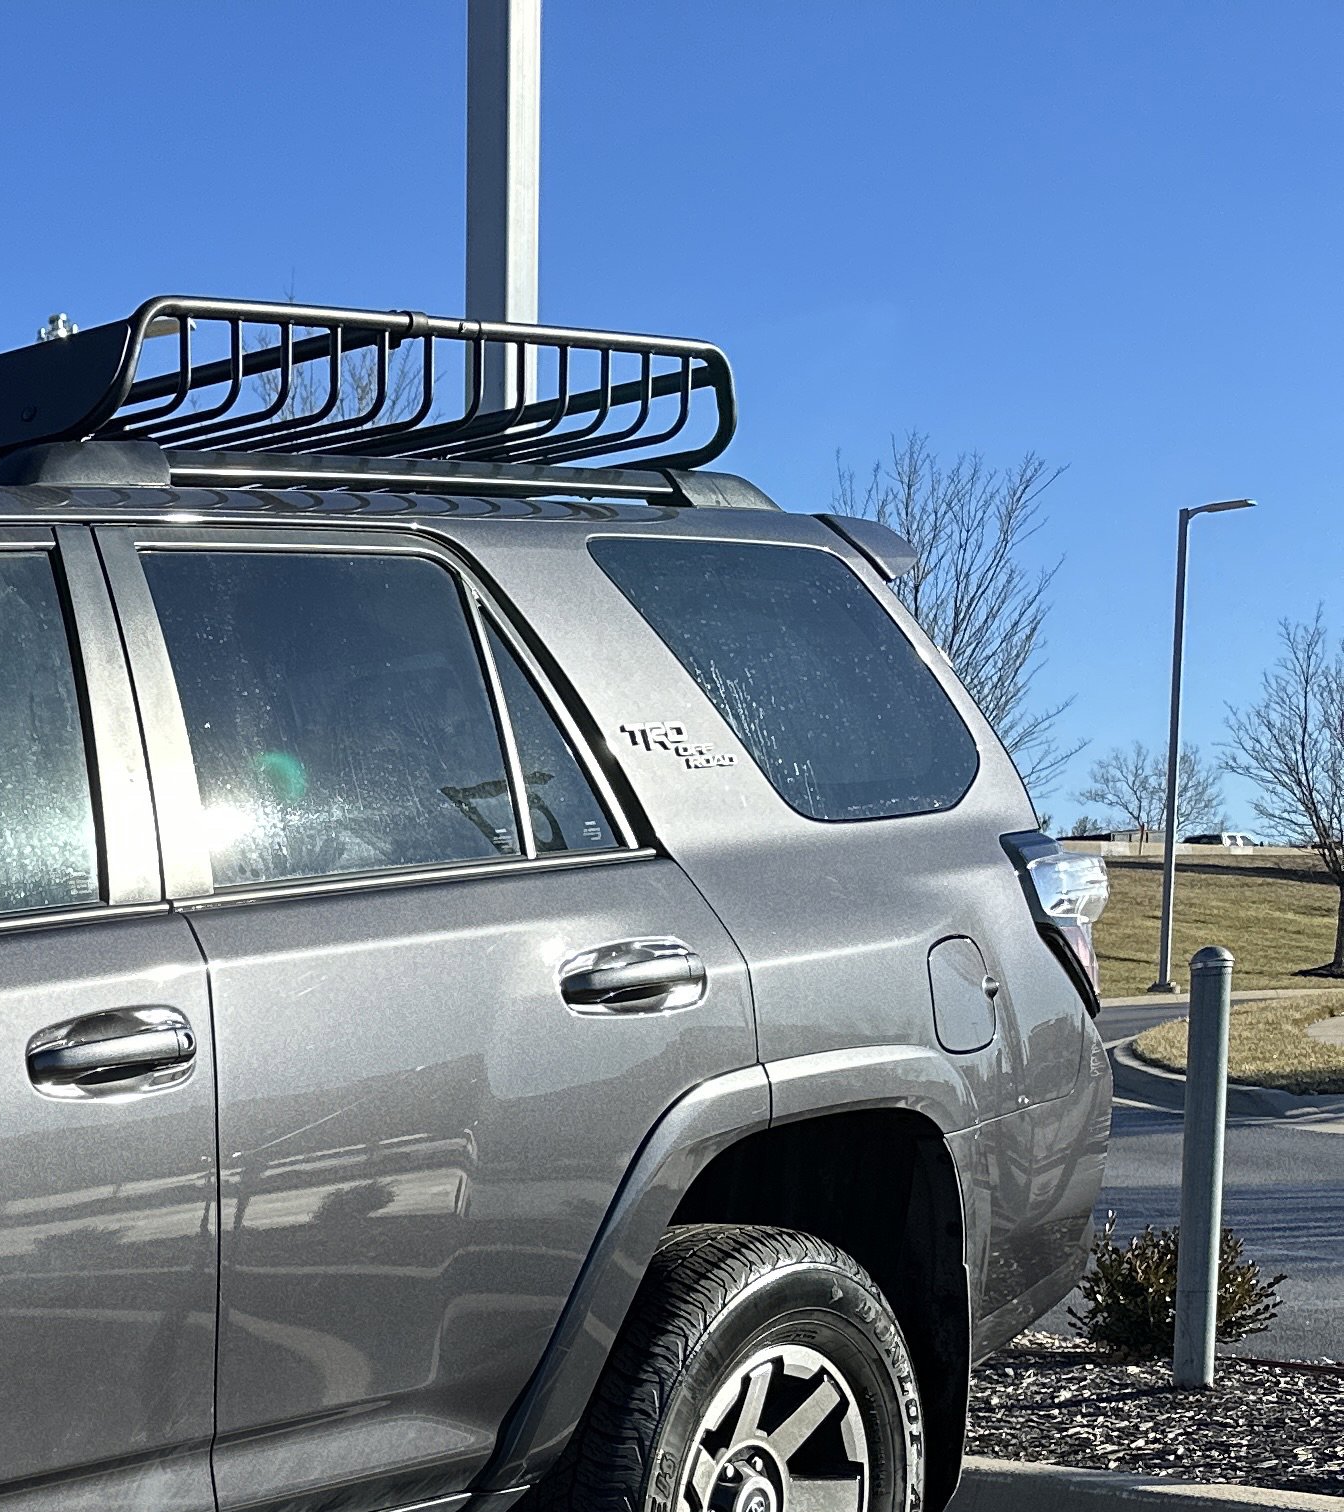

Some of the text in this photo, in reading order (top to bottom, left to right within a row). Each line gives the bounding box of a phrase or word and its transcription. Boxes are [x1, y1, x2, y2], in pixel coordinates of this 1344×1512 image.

[619, 719, 689, 752] TRD
[674, 744, 715, 758] OFF
[684, 753, 738, 770] ROAD
[855, 1301, 923, 1459] DUNLOP
